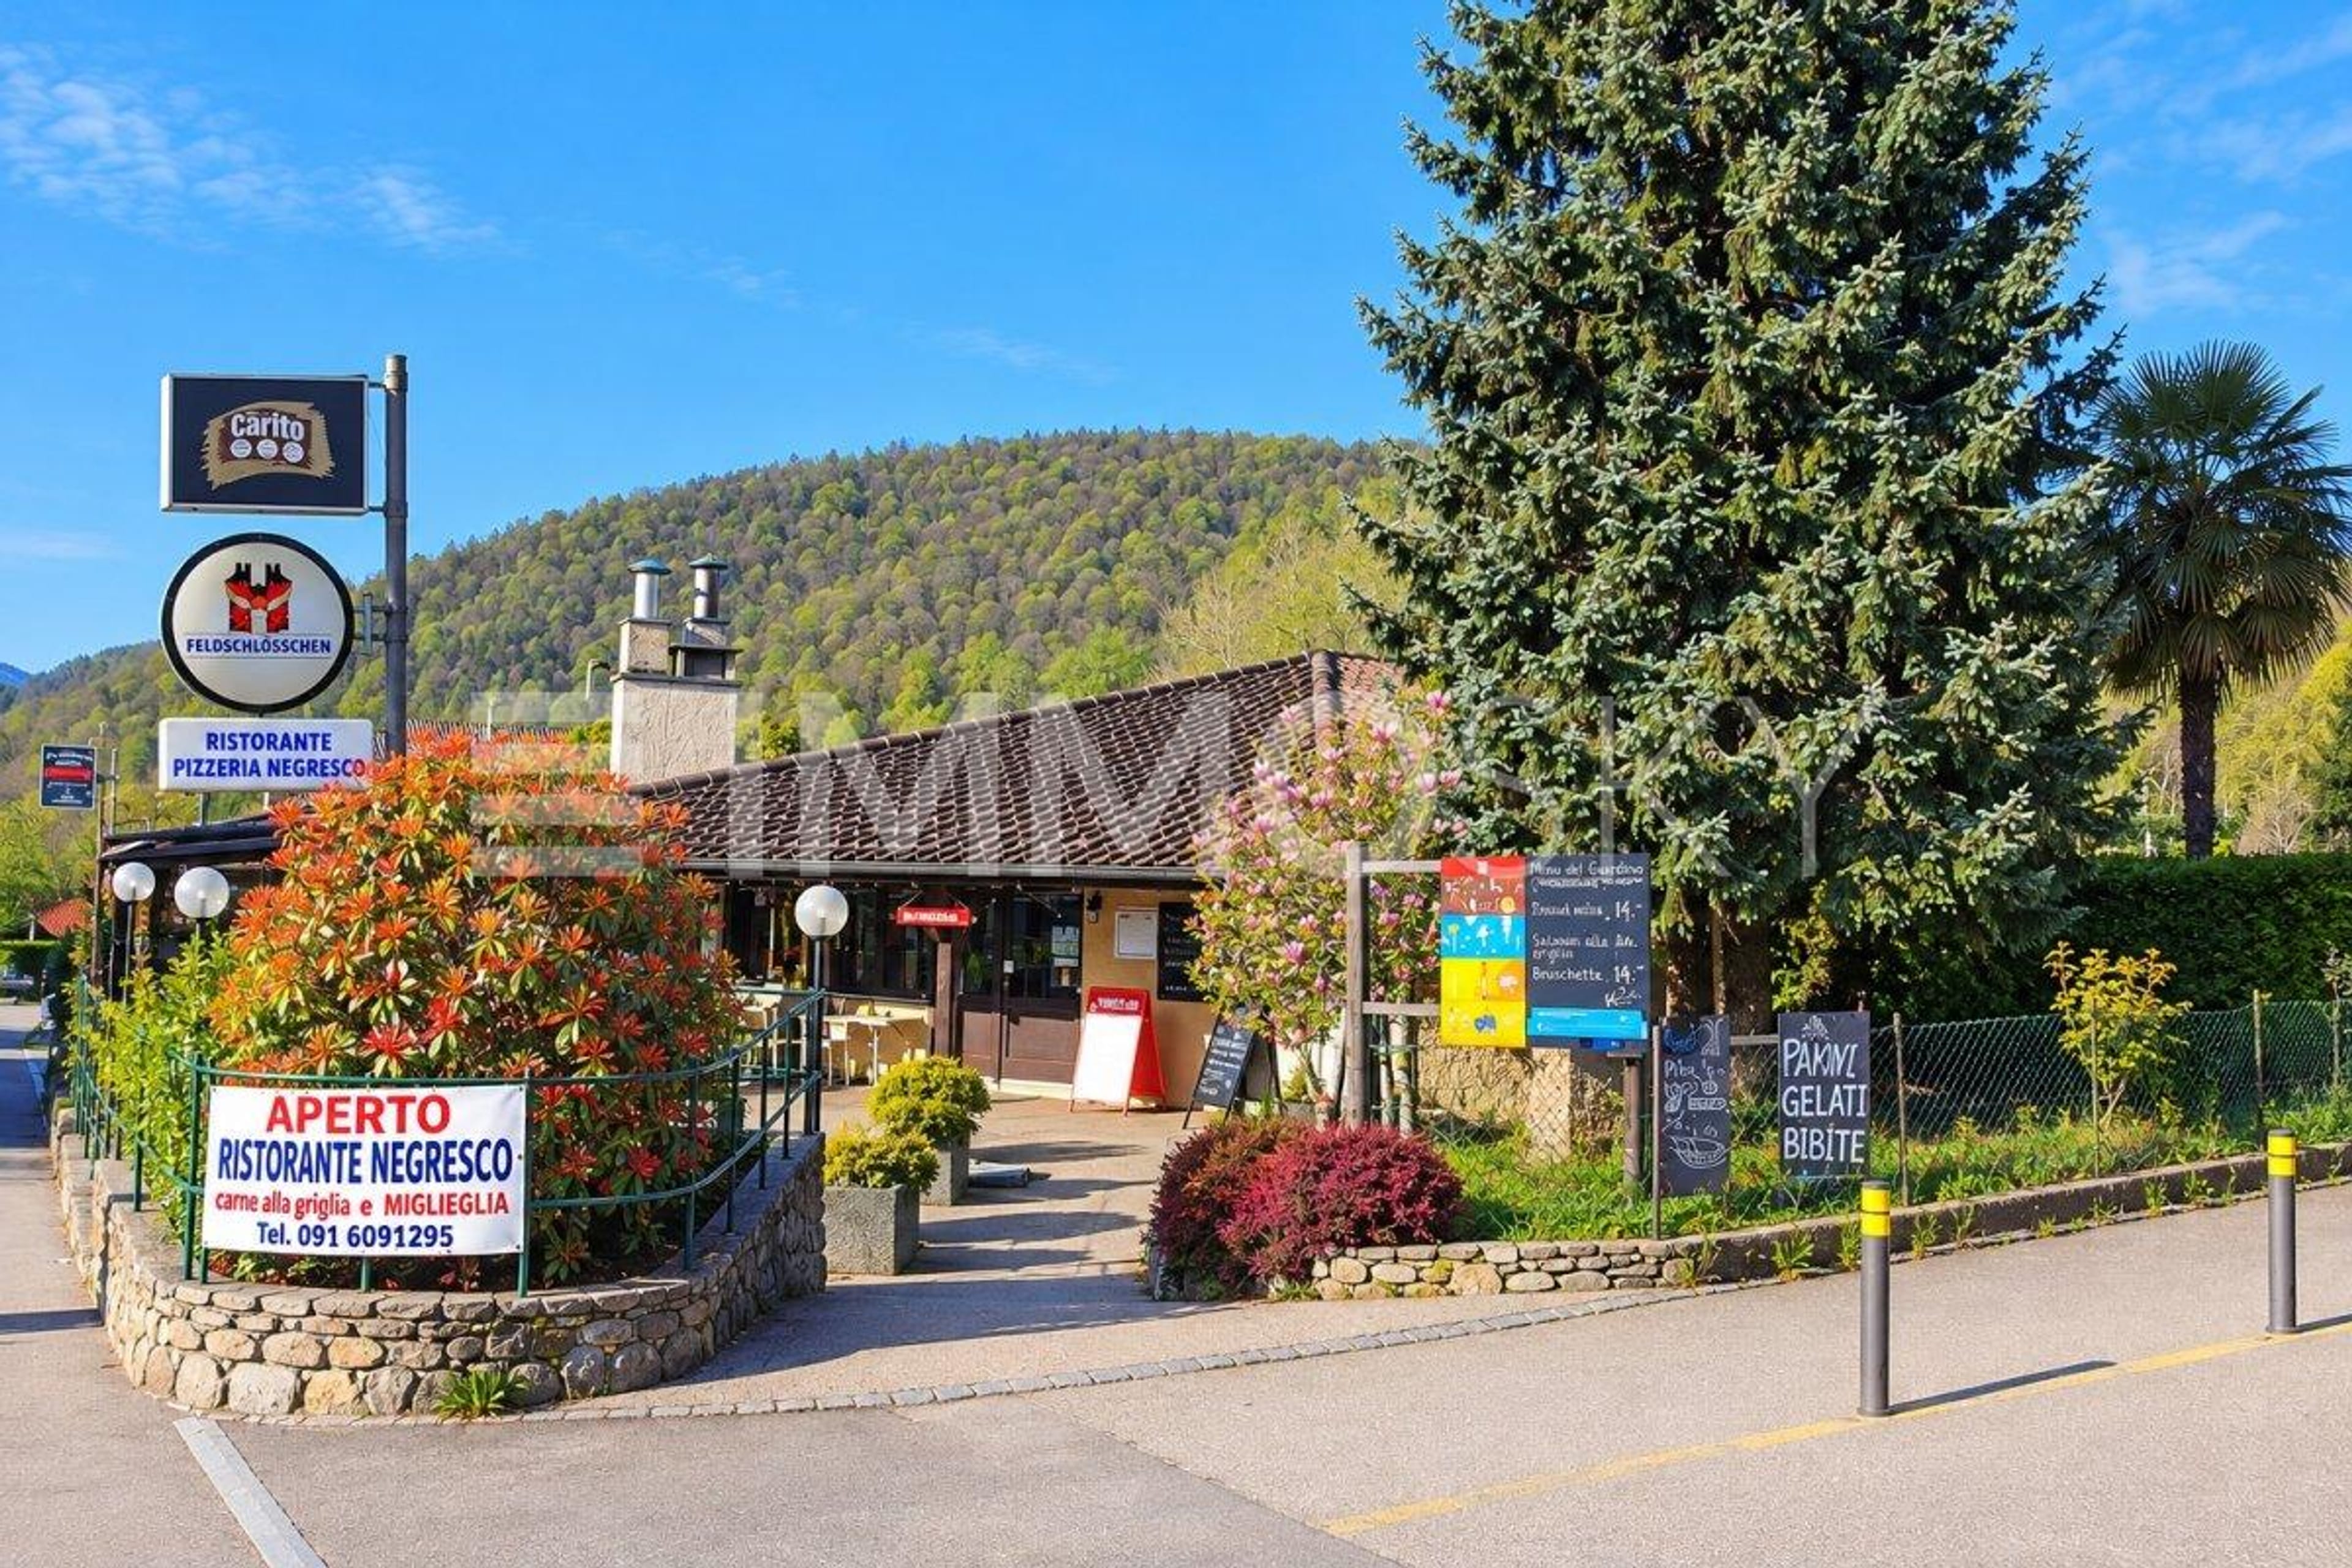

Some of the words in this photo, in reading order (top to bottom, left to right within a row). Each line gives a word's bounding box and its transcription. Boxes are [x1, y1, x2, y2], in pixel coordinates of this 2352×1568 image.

[231, 412, 305, 442] Carito
[206, 733, 332, 752] RISTORANTE
[173, 758, 261, 777] PIZZERIA
[267, 758, 366, 777] NEGRESCO
[266, 1094, 451, 1134] APERTO
[1782, 1084, 1868, 1118] GELATI
[217, 1138, 362, 1183] RISTORANTE
[371, 1138, 513, 1184] NEGRESCO
[215, 1190, 258, 1213] carne
[262, 1191, 291, 1215] alla
[294, 1192, 351, 1221] griglia
[360, 1199, 373, 1215] e
[383, 1192, 509, 1216] MIGLIEGLIA
[257, 1222, 291, 1246] Tel.
[298, 1224, 337, 1246] 091
[348, 1224, 453, 1248] 6091295
